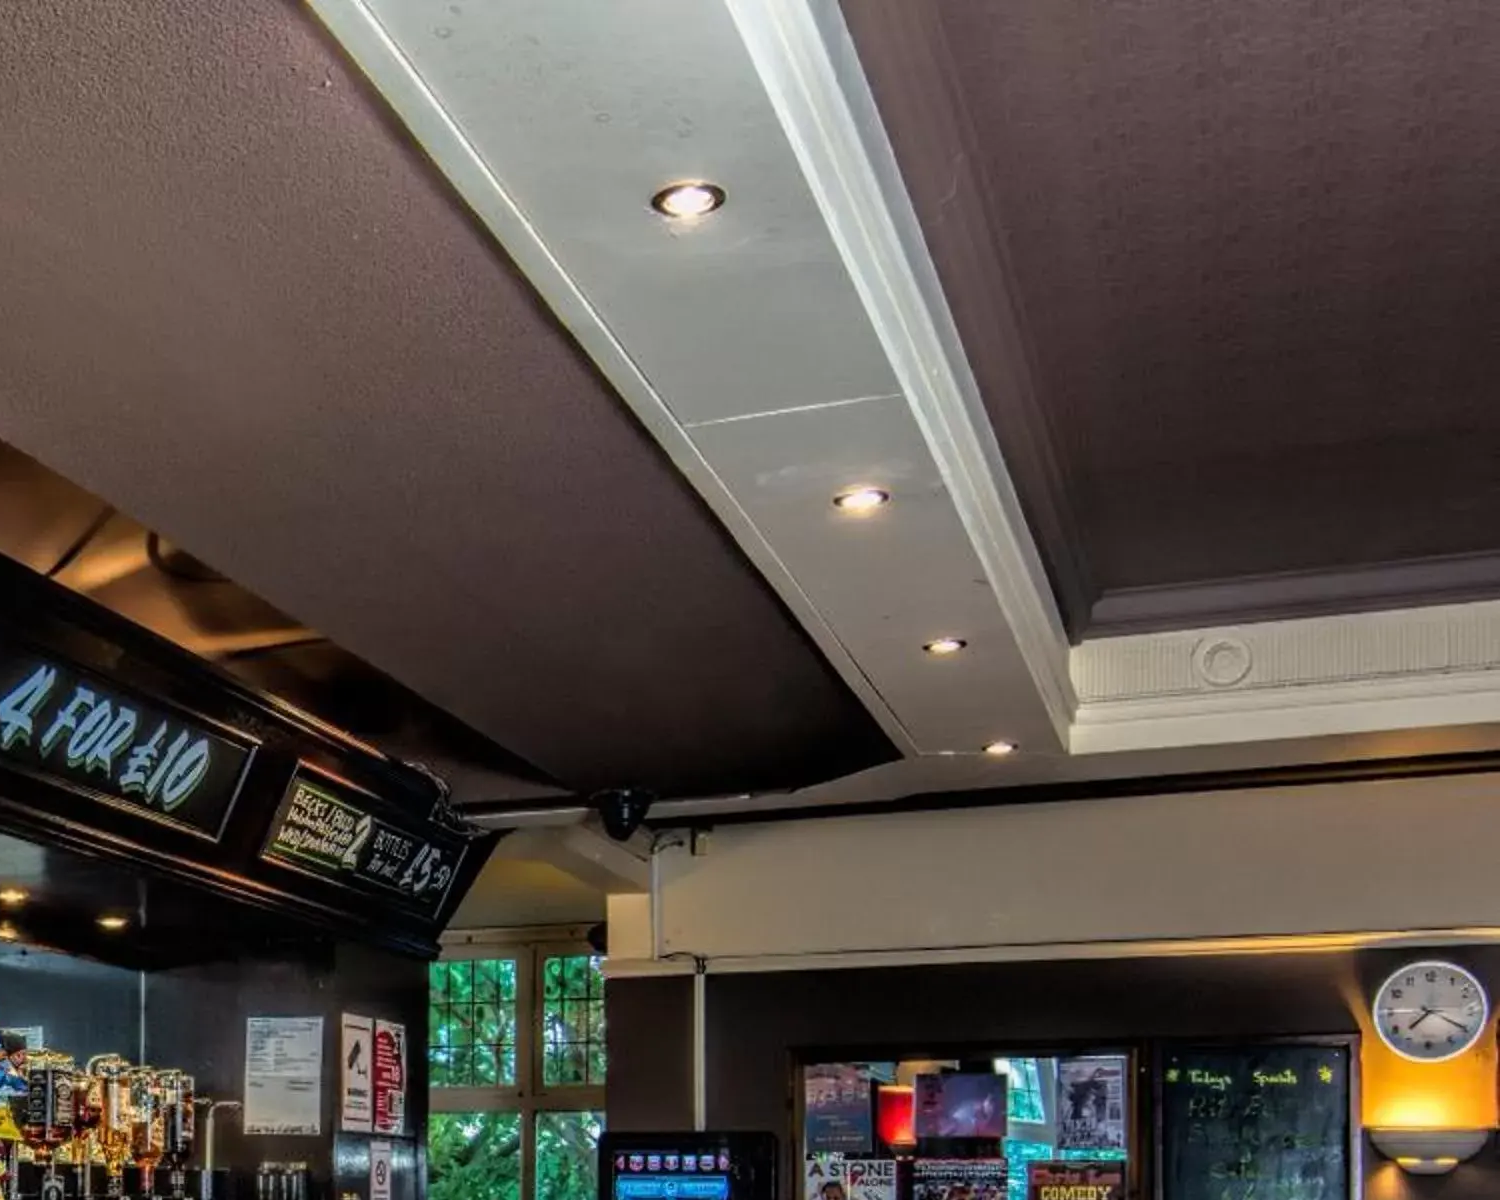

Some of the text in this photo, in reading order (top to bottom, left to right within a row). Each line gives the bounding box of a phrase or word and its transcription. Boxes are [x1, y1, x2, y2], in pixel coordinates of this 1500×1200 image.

[40, 685, 138, 774] FOR
[118, 719, 212, 813] £10
[808, 1163, 824, 1177] A
[829, 1162, 895, 1177] STONE
